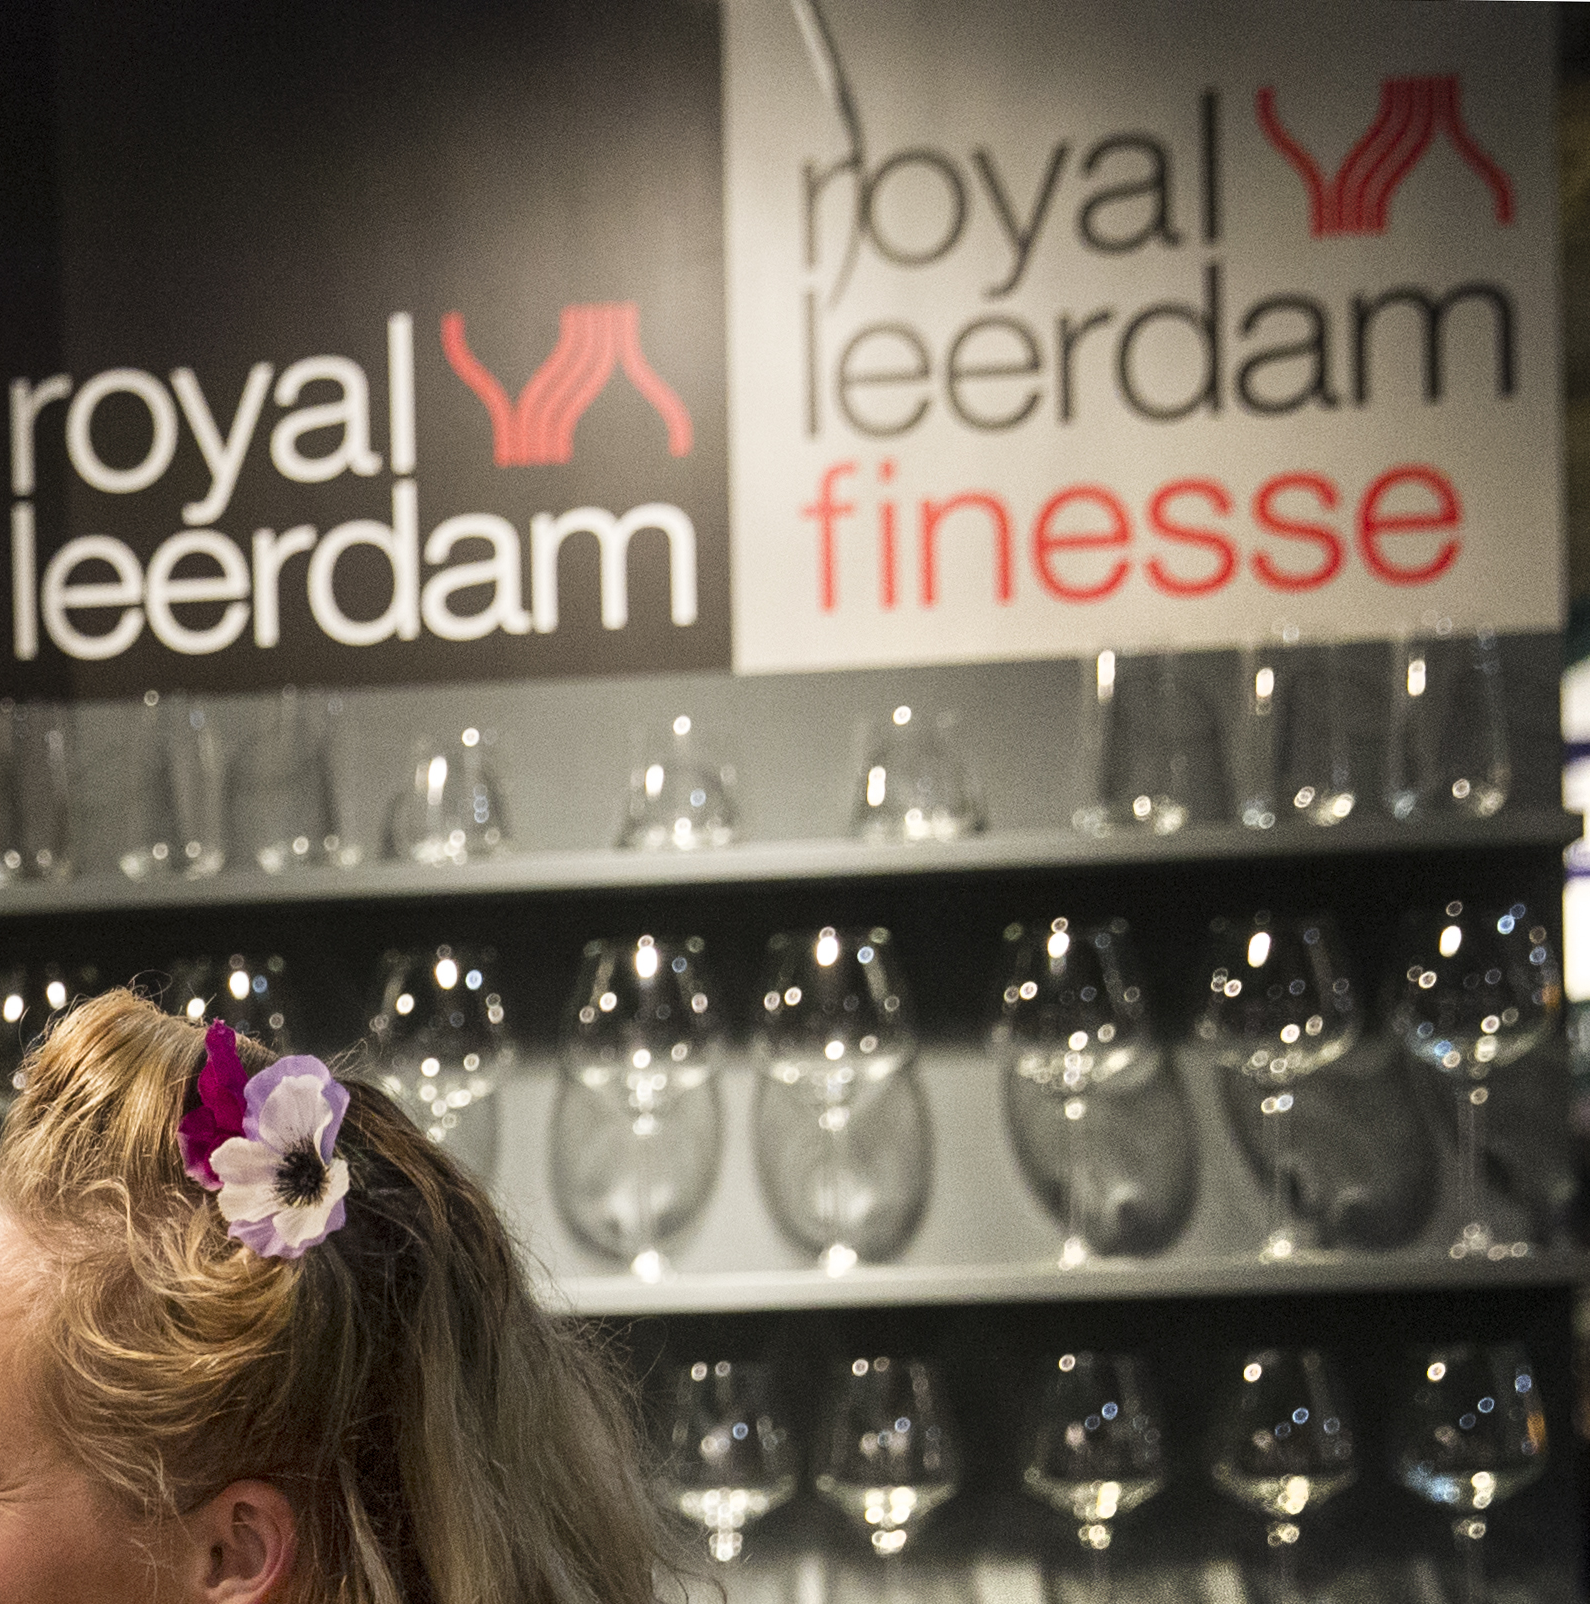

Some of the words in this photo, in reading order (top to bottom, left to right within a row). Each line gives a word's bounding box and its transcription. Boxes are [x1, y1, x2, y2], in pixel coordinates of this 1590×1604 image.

[800, 86, 1222, 297] royal
[8, 310, 418, 527] royal
[805, 262, 1522, 442] leerdam
[10, 480, 700, 663] leerdam
[802, 464, 1466, 614] finesse
